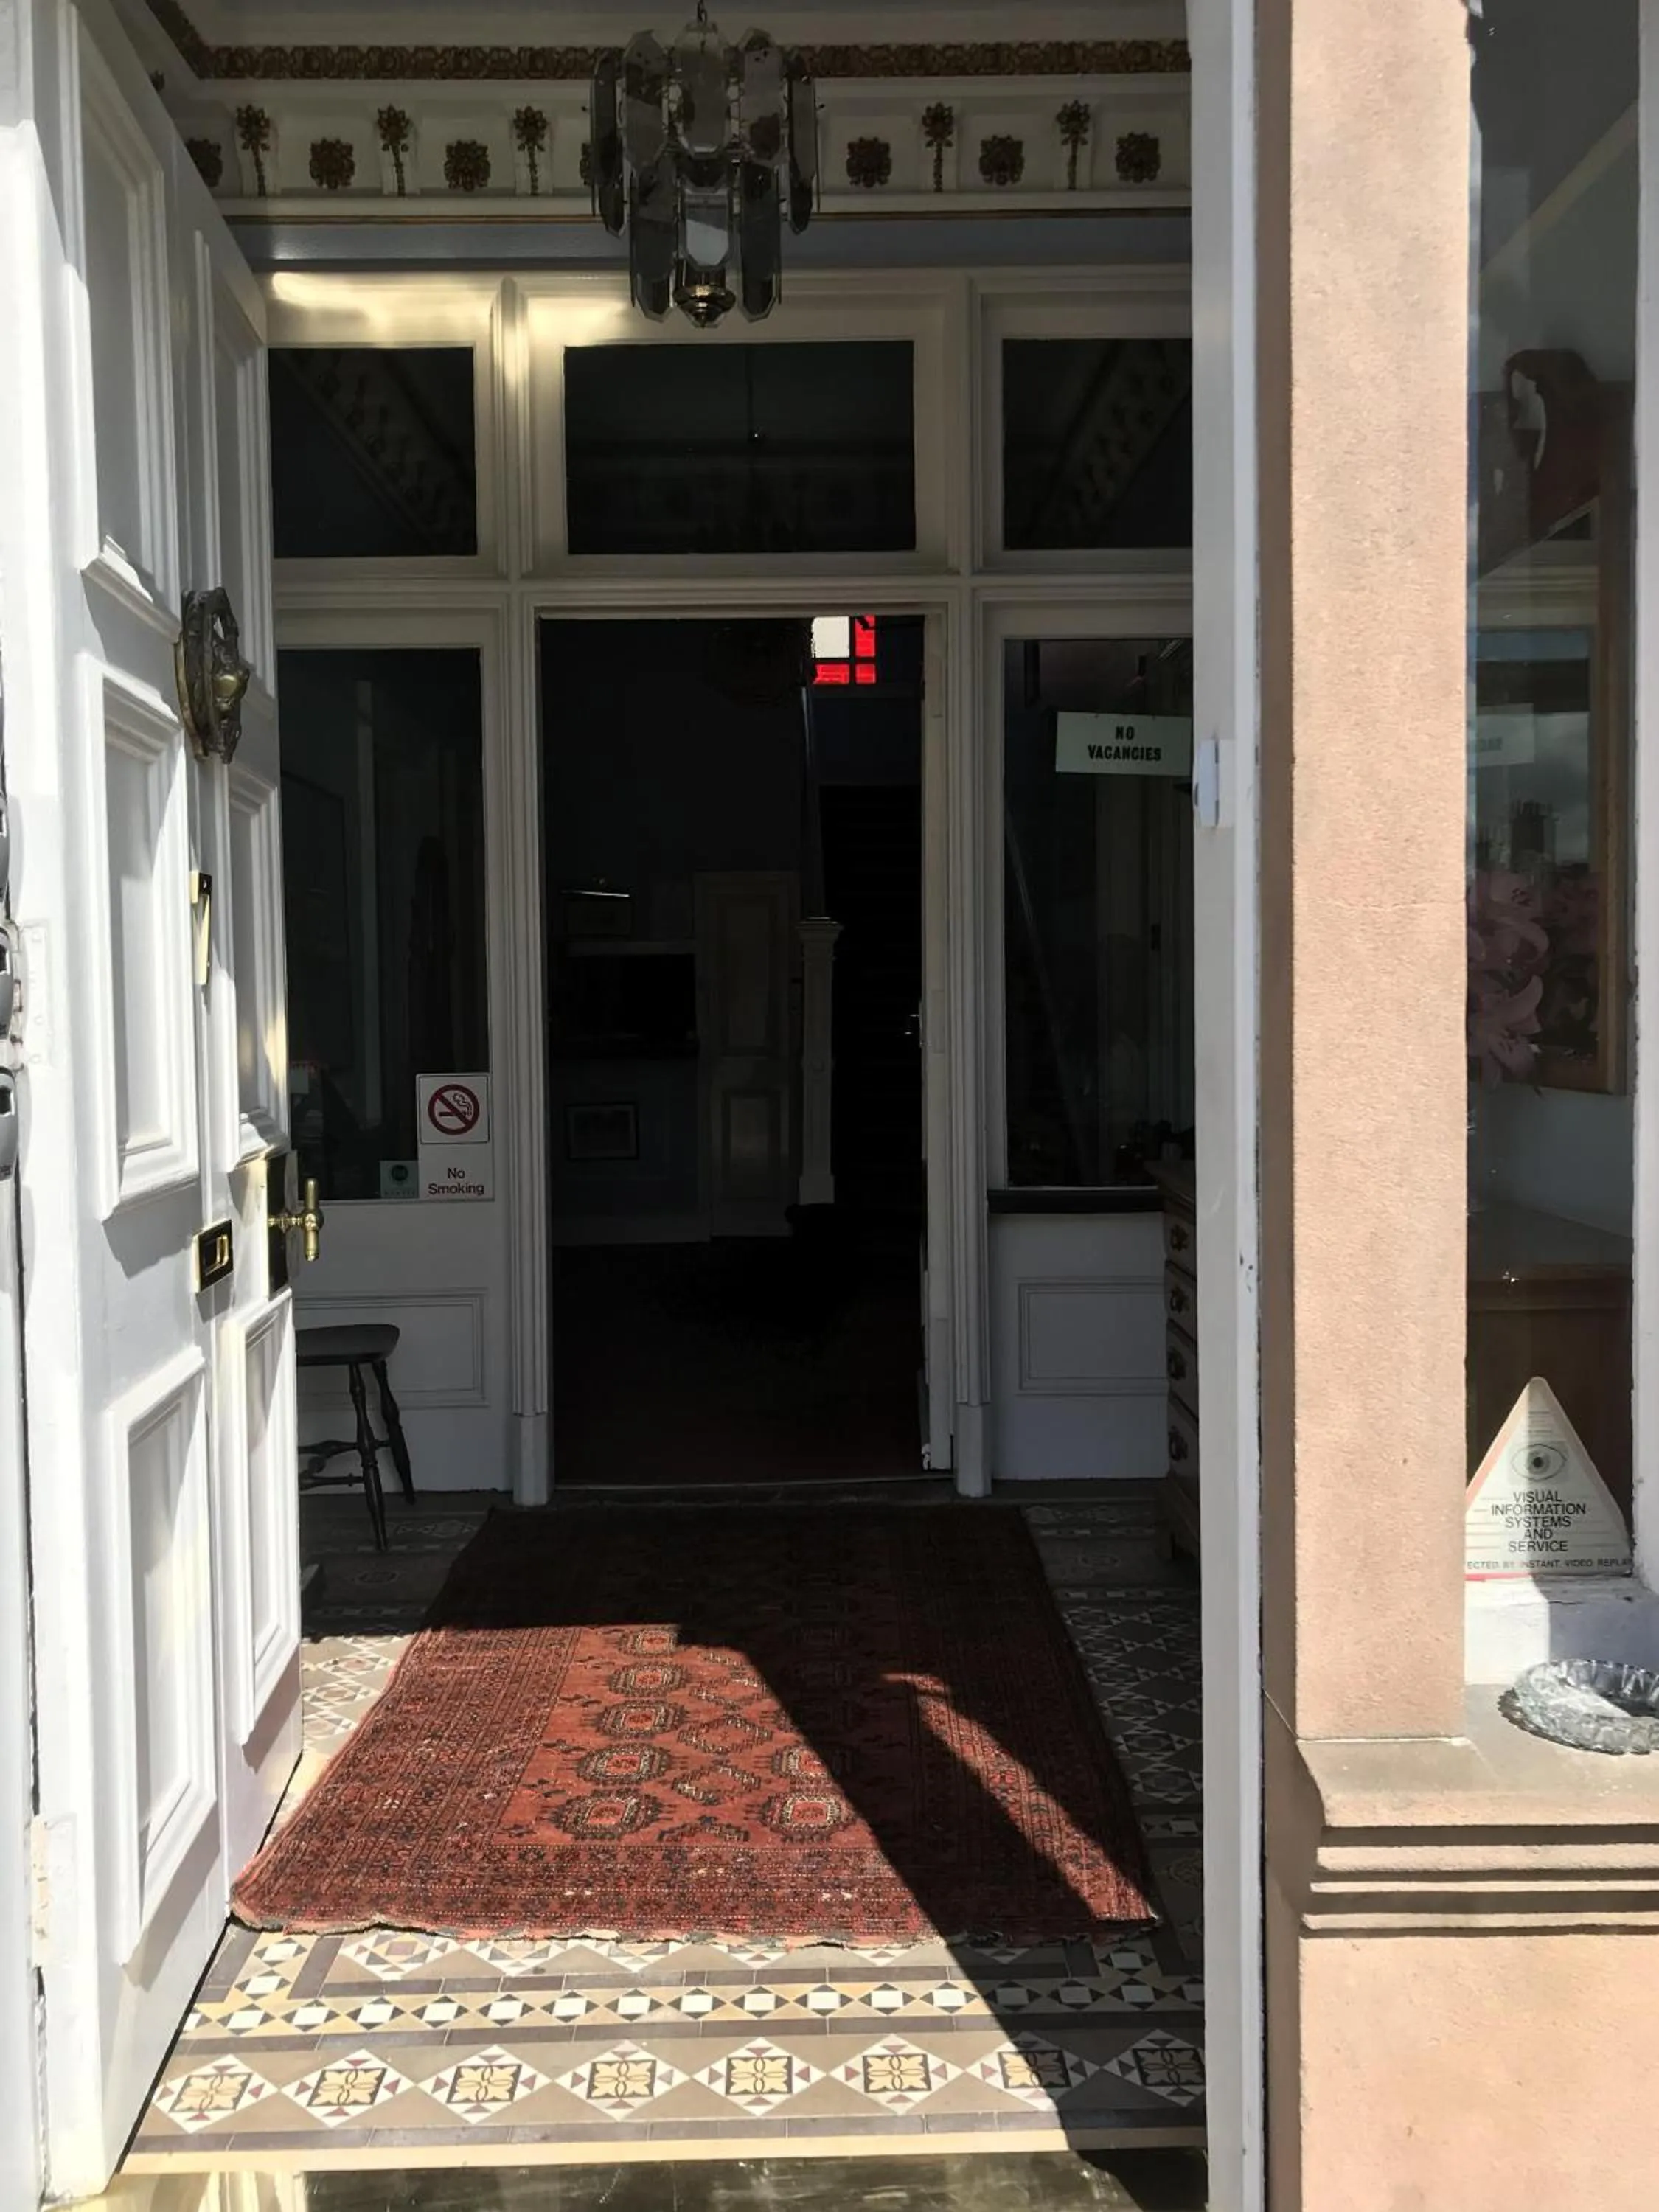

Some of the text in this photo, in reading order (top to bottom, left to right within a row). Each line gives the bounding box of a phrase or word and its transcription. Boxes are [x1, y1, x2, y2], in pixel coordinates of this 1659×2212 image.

[1115, 726, 1135, 740] NO
[1088, 744, 1161, 761] VACANCIES
[448, 1167, 465, 1179] No
[428, 1183, 484, 1196] Smoking
[1513, 1490, 1562, 1502] VISUAL
[1491, 1503, 1586, 1515] INFORMATION
[1506, 1516, 1571, 1528] SYSTEMS
[1524, 1529, 1554, 1540] AND
[1509, 1541, 1568, 1552] SERVICE
[1467, 1560, 1497, 1569] ECTED
[1520, 1559, 1560, 1569] NSTANT
[1565, 1559, 1593, 1568] VIDEO
